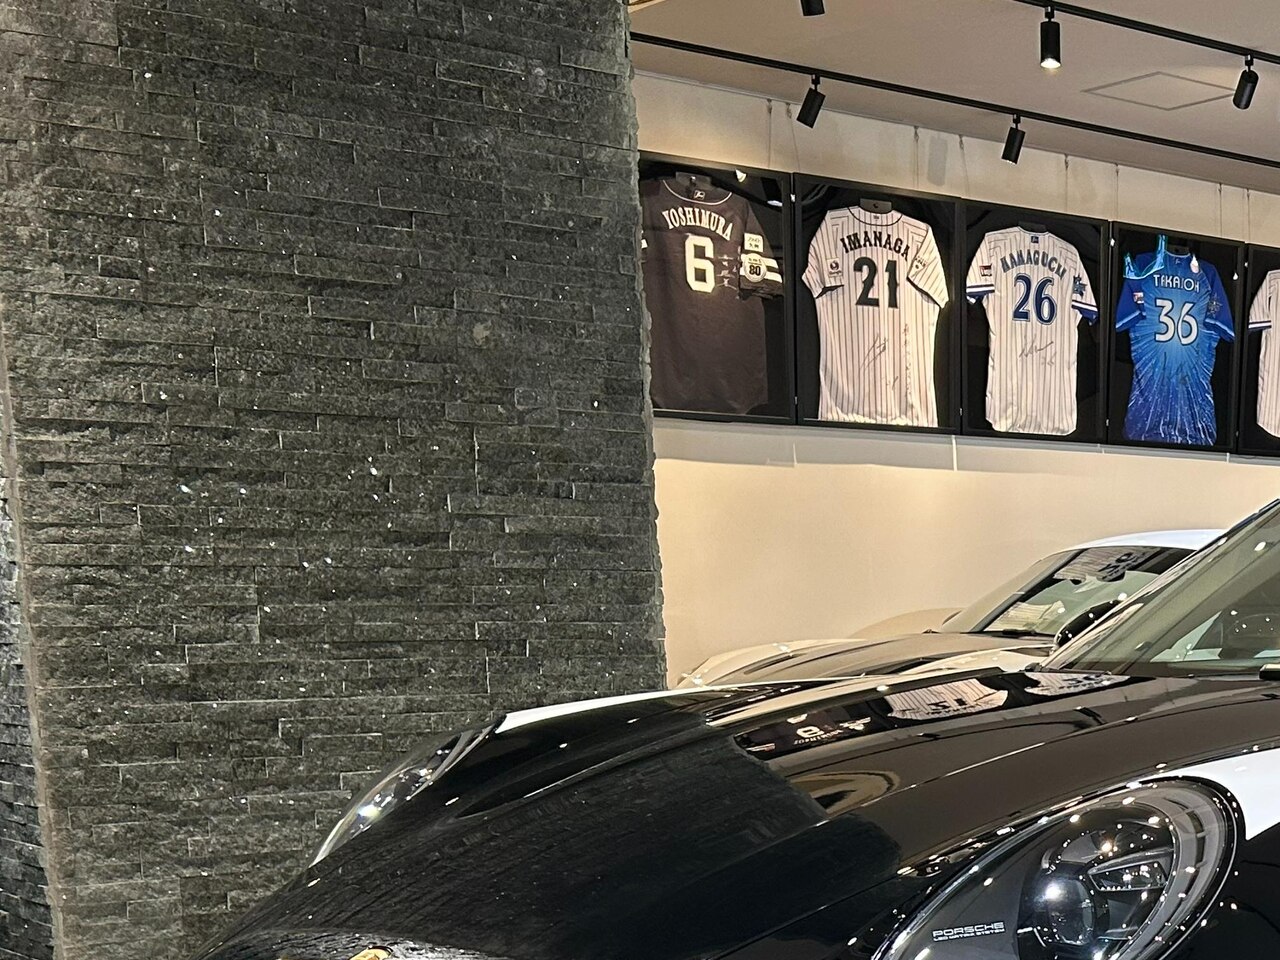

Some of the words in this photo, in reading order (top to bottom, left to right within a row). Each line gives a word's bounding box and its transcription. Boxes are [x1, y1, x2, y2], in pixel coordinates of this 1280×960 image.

[661, 207, 733, 241] YOSHIMURA
[840, 231, 910, 262] IMANAGA
[684, 234, 716, 293] 6
[853, 256, 899, 309] 21
[1012, 272, 1058, 325] 26
[1155, 298, 1199, 346] 36
[932, 921, 1005, 938] PORSCHE
